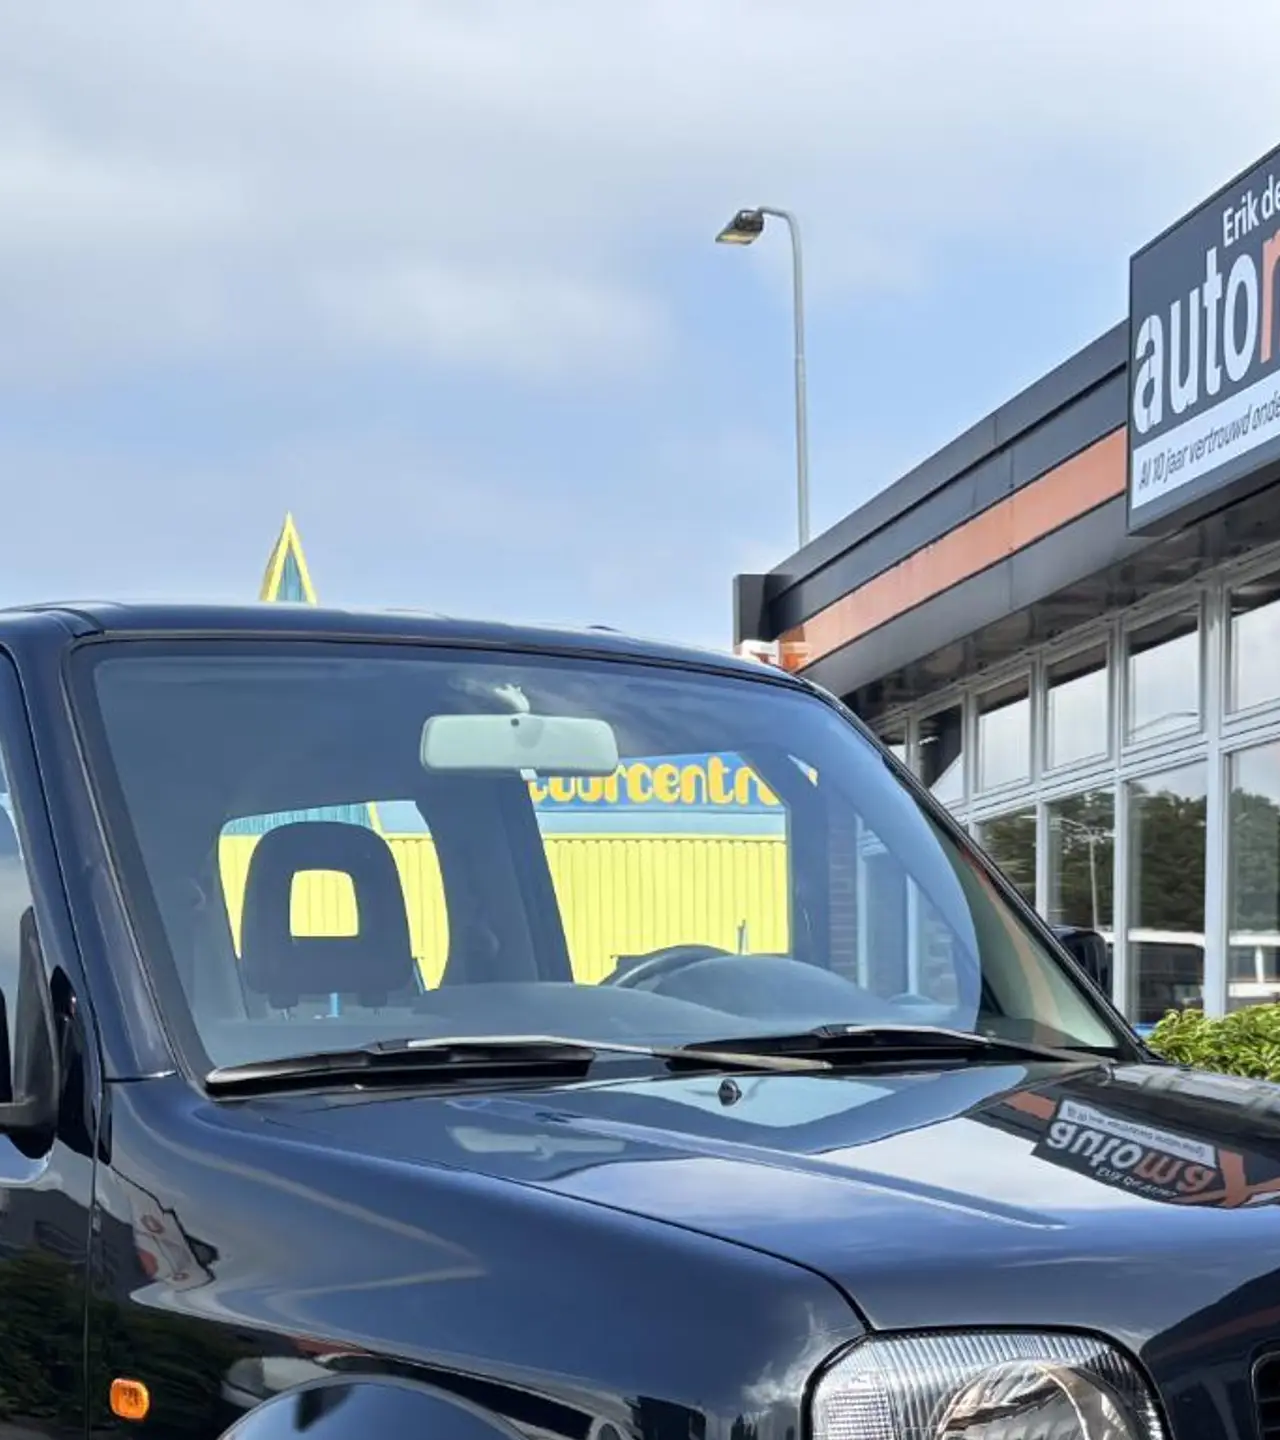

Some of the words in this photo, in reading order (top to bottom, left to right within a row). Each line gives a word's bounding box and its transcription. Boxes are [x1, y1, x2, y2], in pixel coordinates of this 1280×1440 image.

[1223, 189, 1259, 248] Erik
[1163, 443, 1190, 483] jaar
[1188, 403, 1253, 464] vertrouwd
